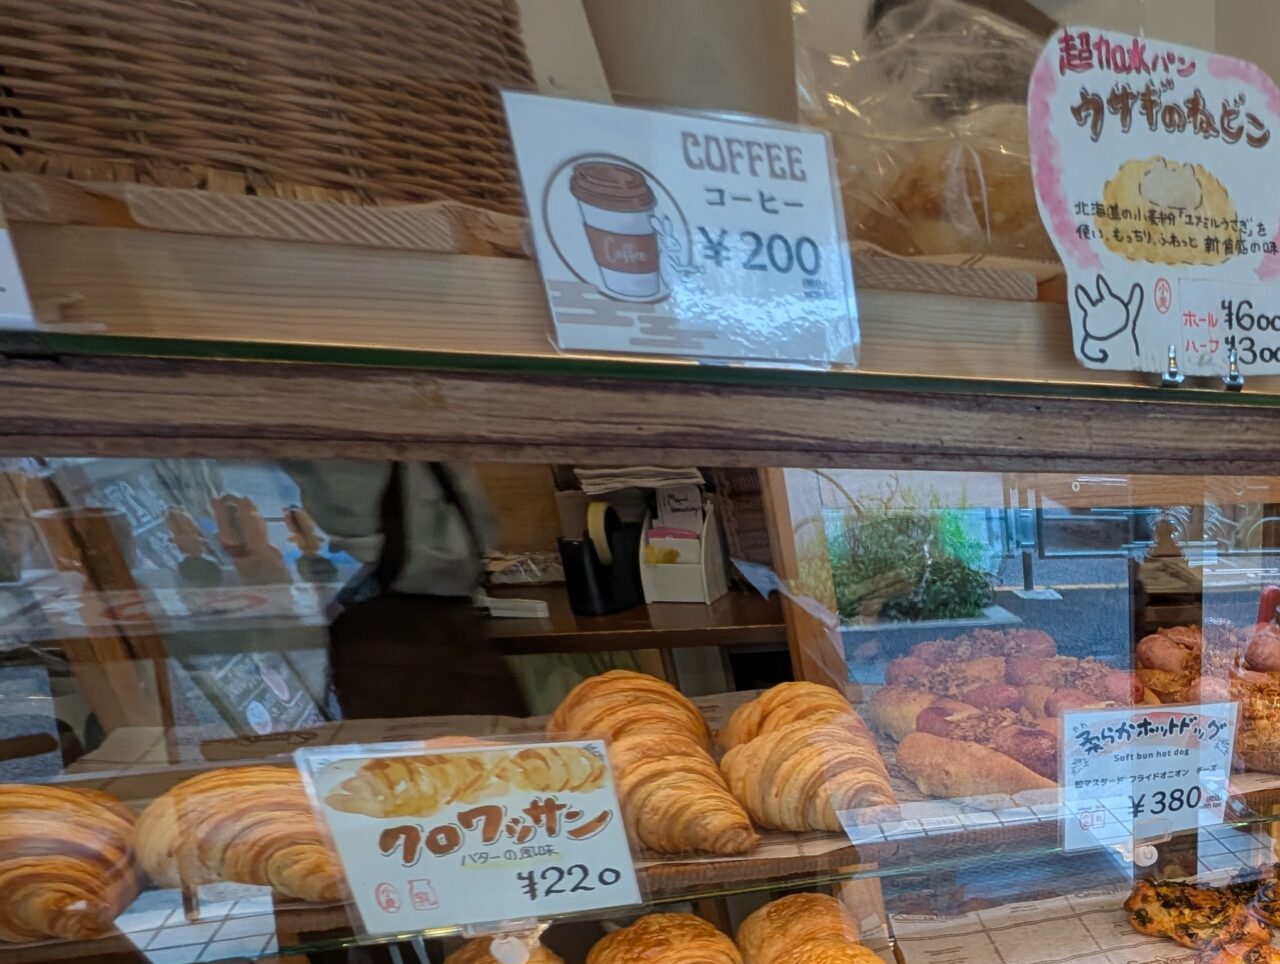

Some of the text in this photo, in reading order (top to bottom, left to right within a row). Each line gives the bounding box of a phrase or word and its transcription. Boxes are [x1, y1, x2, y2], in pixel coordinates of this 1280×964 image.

[1058, 32, 1196, 76] 超加水パン
[1071, 79, 1271, 148] ウサギのねどこ
[681, 131, 808, 183] COFFEE
[705, 188, 805, 214] コーヒー
[602, 236, 649, 265] Coffee
[699, 227, 822, 276] ¥200
[1183, 311, 1219, 328] ホール
[1185, 338, 1220, 355] ハーフ
[1075, 716, 1228, 756] 柔らかホットドッグ
[1114, 748, 1190, 763] Soft bun hot dog
[1129, 769, 1190, 783] フライドオニオン
[1128, 786, 1202, 818] ¥380
[378, 795, 613, 868] クロワッサン
[460, 845, 560, 867] バターの風味
[517, 863, 622, 901] ¥220
